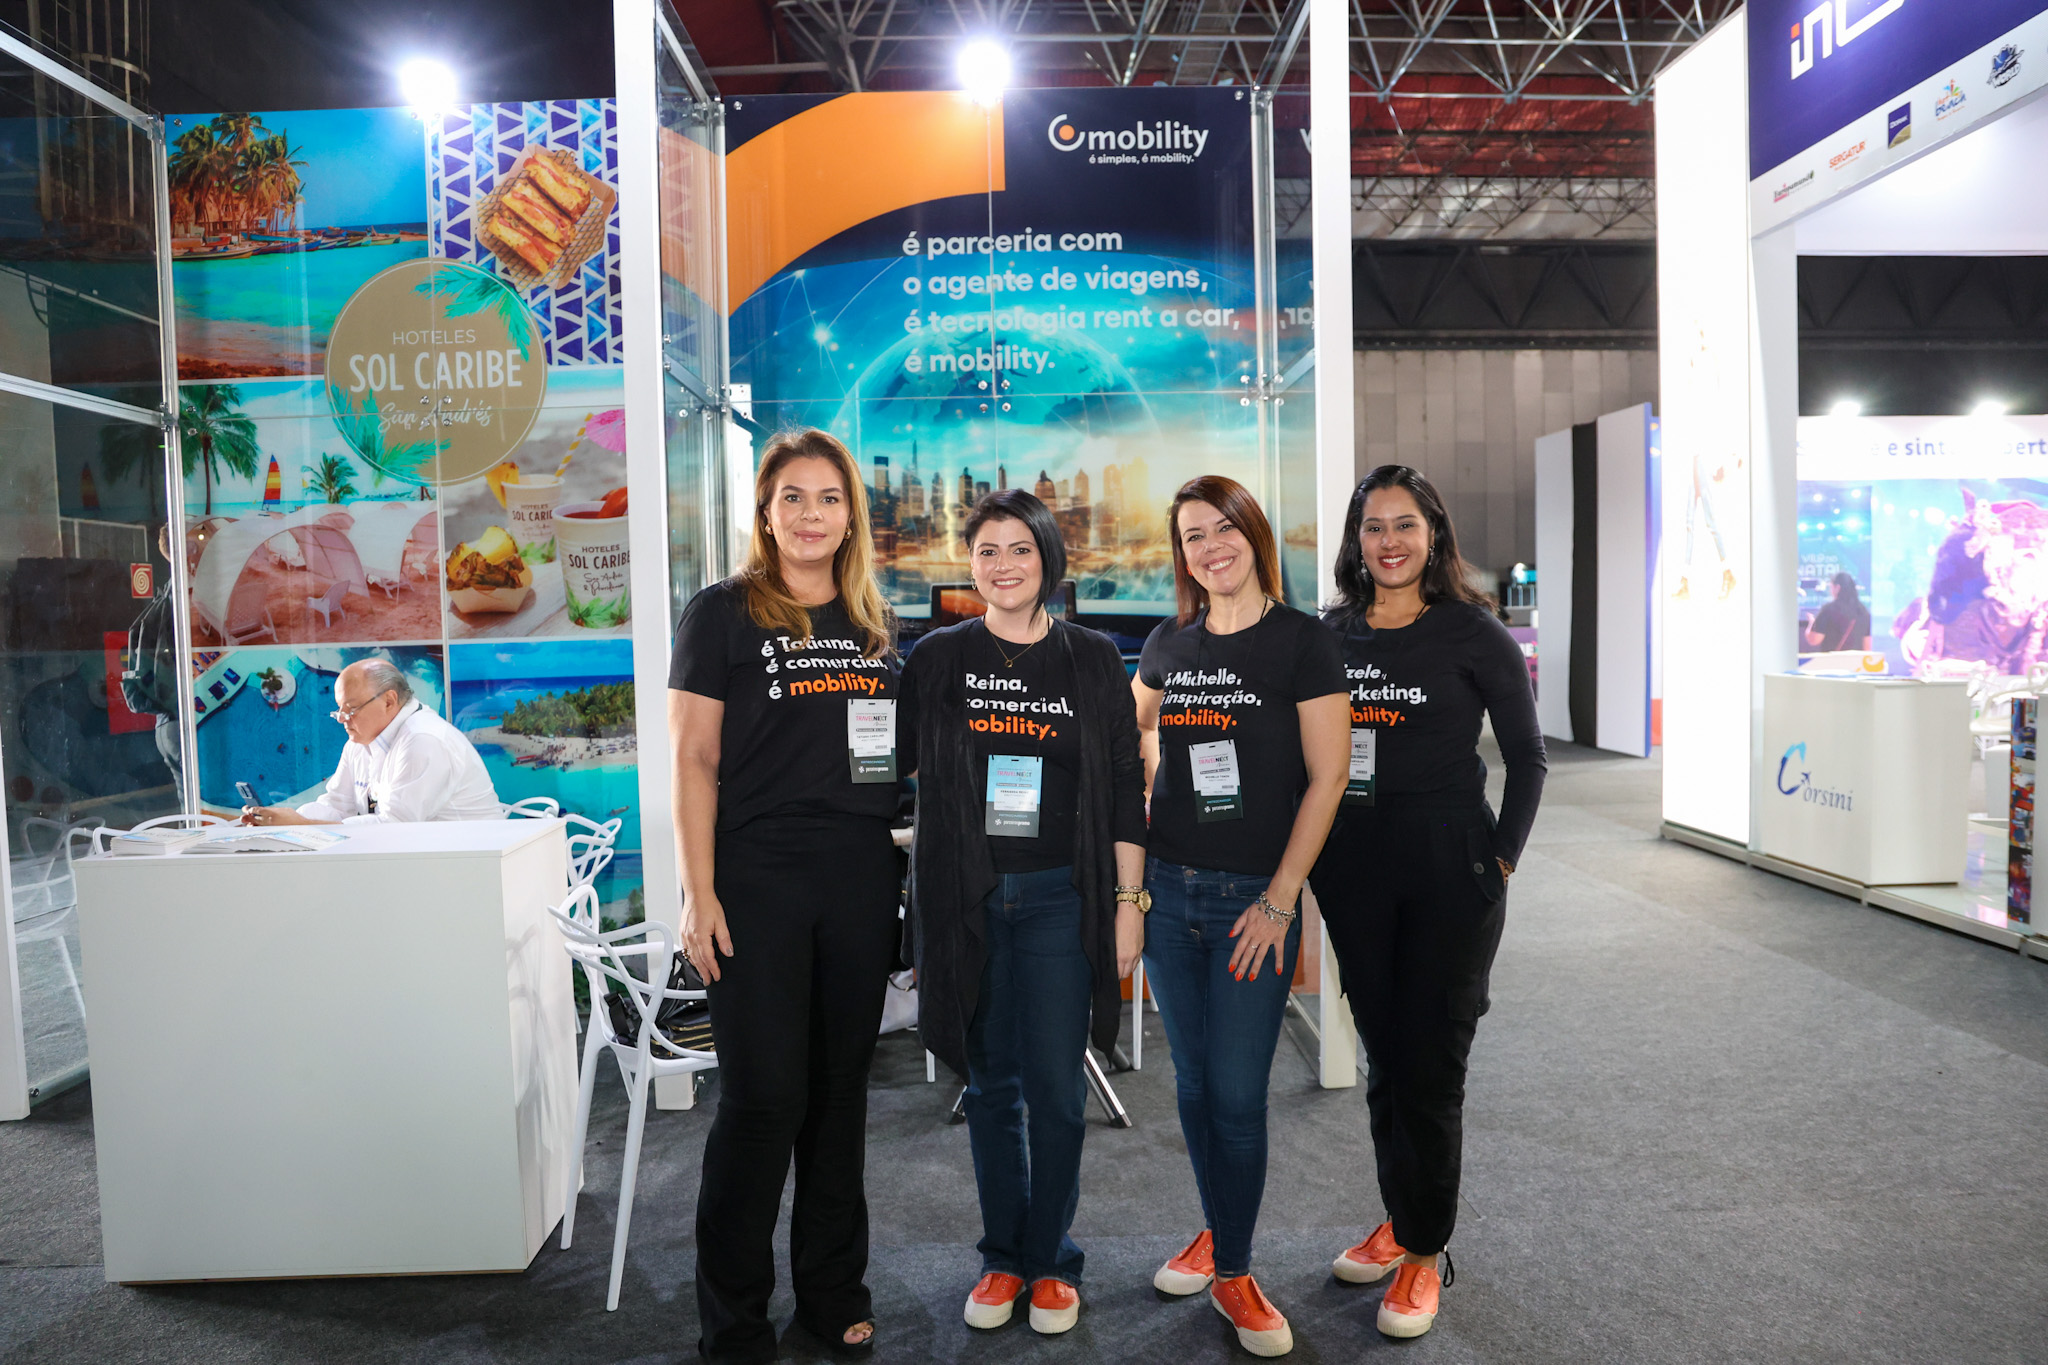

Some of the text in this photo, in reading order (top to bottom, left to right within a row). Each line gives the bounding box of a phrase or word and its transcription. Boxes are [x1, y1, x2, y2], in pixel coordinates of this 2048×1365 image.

[1088, 121, 1209, 157] mobility
[1089, 153, 1195, 166] é simples, é mobility.
[902, 227, 1123, 260] é parceria com
[903, 264, 1209, 299] o agente de viagens,
[904, 305, 1240, 336] é tecnologia rent a car,
[393, 330, 477, 345] HOTELES
[349, 349, 522, 392] SOL CARIBE
[905, 346, 1056, 374] é mobility.
[378, 399, 492, 433] San Andrés
[512, 509, 552, 521] SOL CARI
[581, 544, 620, 553] HOTELES
[569, 554, 589, 569] SOL
[761, 641, 775, 657] é
[766, 654, 889, 674] é comercial,
[768, 672, 885, 700] é mobility.
[965, 673, 1028, 693] Reina,
[1172, 668, 1242, 687] Michelle,
[1350, 683, 1427, 705] rketing,
[966, 697, 1074, 717] omercial,
[1350, 705, 1406, 726] bility.
[968, 714, 1058, 741] obility.
[1161, 708, 1238, 731] mobility.
[1777, 741, 1853, 812] Corsini
